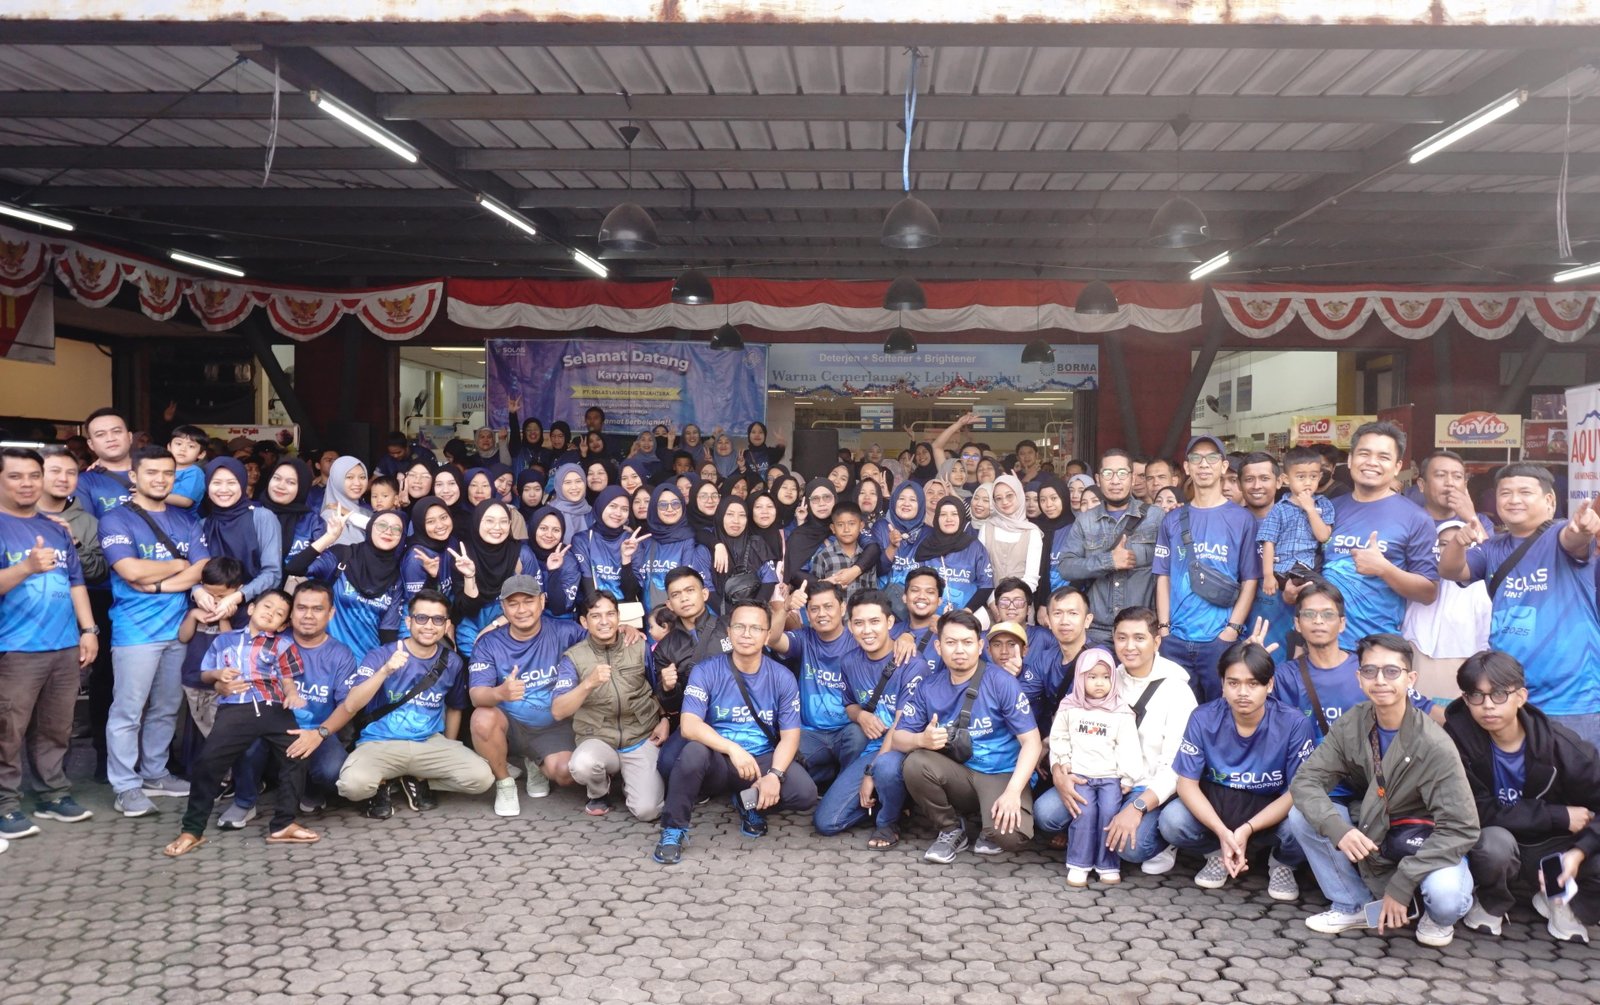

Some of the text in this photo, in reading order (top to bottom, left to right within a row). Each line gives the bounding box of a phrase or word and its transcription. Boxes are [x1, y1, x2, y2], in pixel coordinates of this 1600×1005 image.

[562, 350, 689, 372] Selamat Datang
[819, 353, 860, 364] Deterjen
[871, 353, 912, 363] Softener
[924, 354, 977, 365] Brightener
[1056, 363, 1097, 372] BORMA
[597, 370, 653, 382] Karyawan
[772, 370, 817, 381] Warna
[821, 370, 897, 384] Cemerlang
[905, 371, 921, 381] 2x
[1299, 420, 1328, 433] SunCo
[1448, 413, 1507, 436] forVita
[1570, 428, 1600, 467] AQU
[596, 564, 622, 575] SOL
[939, 566, 971, 578] SOLAS
[1501, 626, 1530, 637] 2025
[521, 664, 559, 683] SOLA
[817, 669, 842, 681] SOL
[294, 681, 329, 697] OLAS
[731, 705, 774, 720] SOAS
[969, 728, 994, 737] OPPING
[1078, 724, 1107, 737] MM
[1229, 769, 1283, 783] SOLAS
[1229, 780, 1284, 790] FUN SHOPPING
